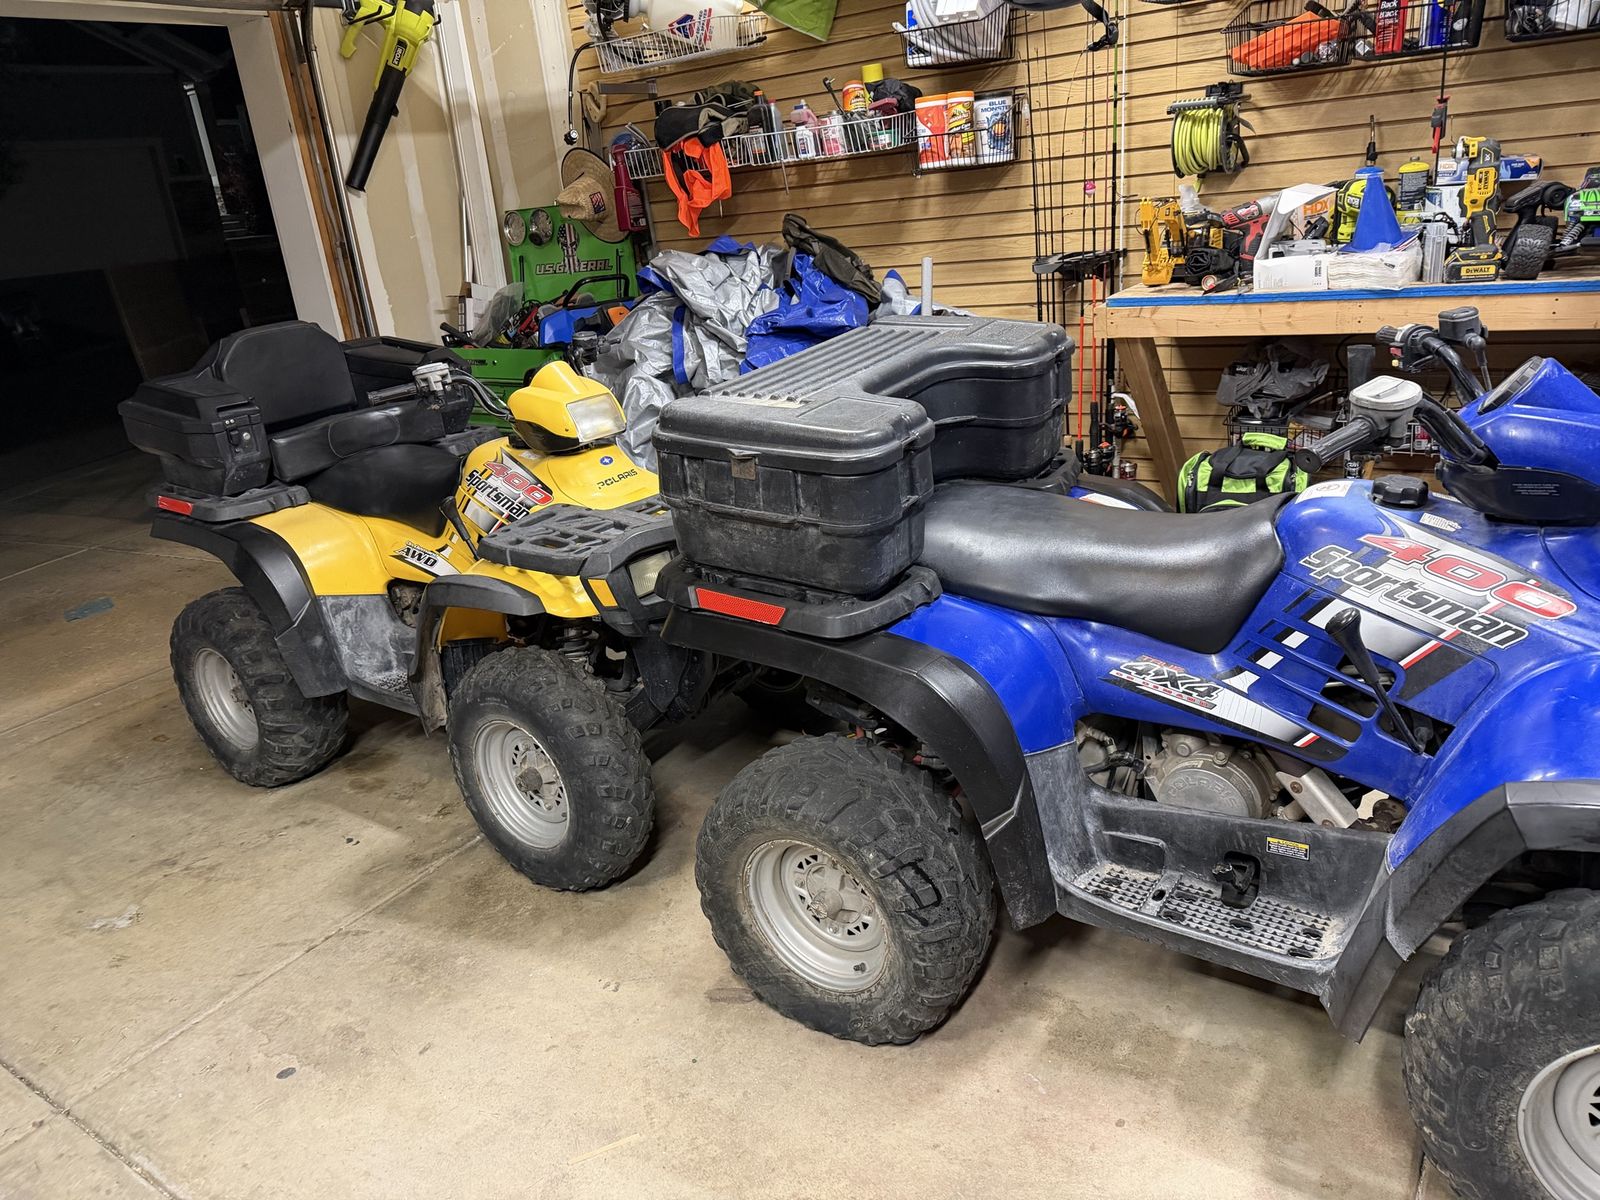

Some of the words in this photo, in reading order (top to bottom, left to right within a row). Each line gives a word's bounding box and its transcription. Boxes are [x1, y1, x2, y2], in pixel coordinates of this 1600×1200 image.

[988, 99, 1007, 107] BLUE
[1303, 198, 1330, 215] HDX
[466, 469, 531, 520] Sportsman
[483, 461, 554, 505] 400
[596, 468, 638, 490] POLARIS
[398, 547, 438, 567] AWD
[1357, 534, 1578, 619] 400
[1299, 544, 1530, 648] Sportsman
